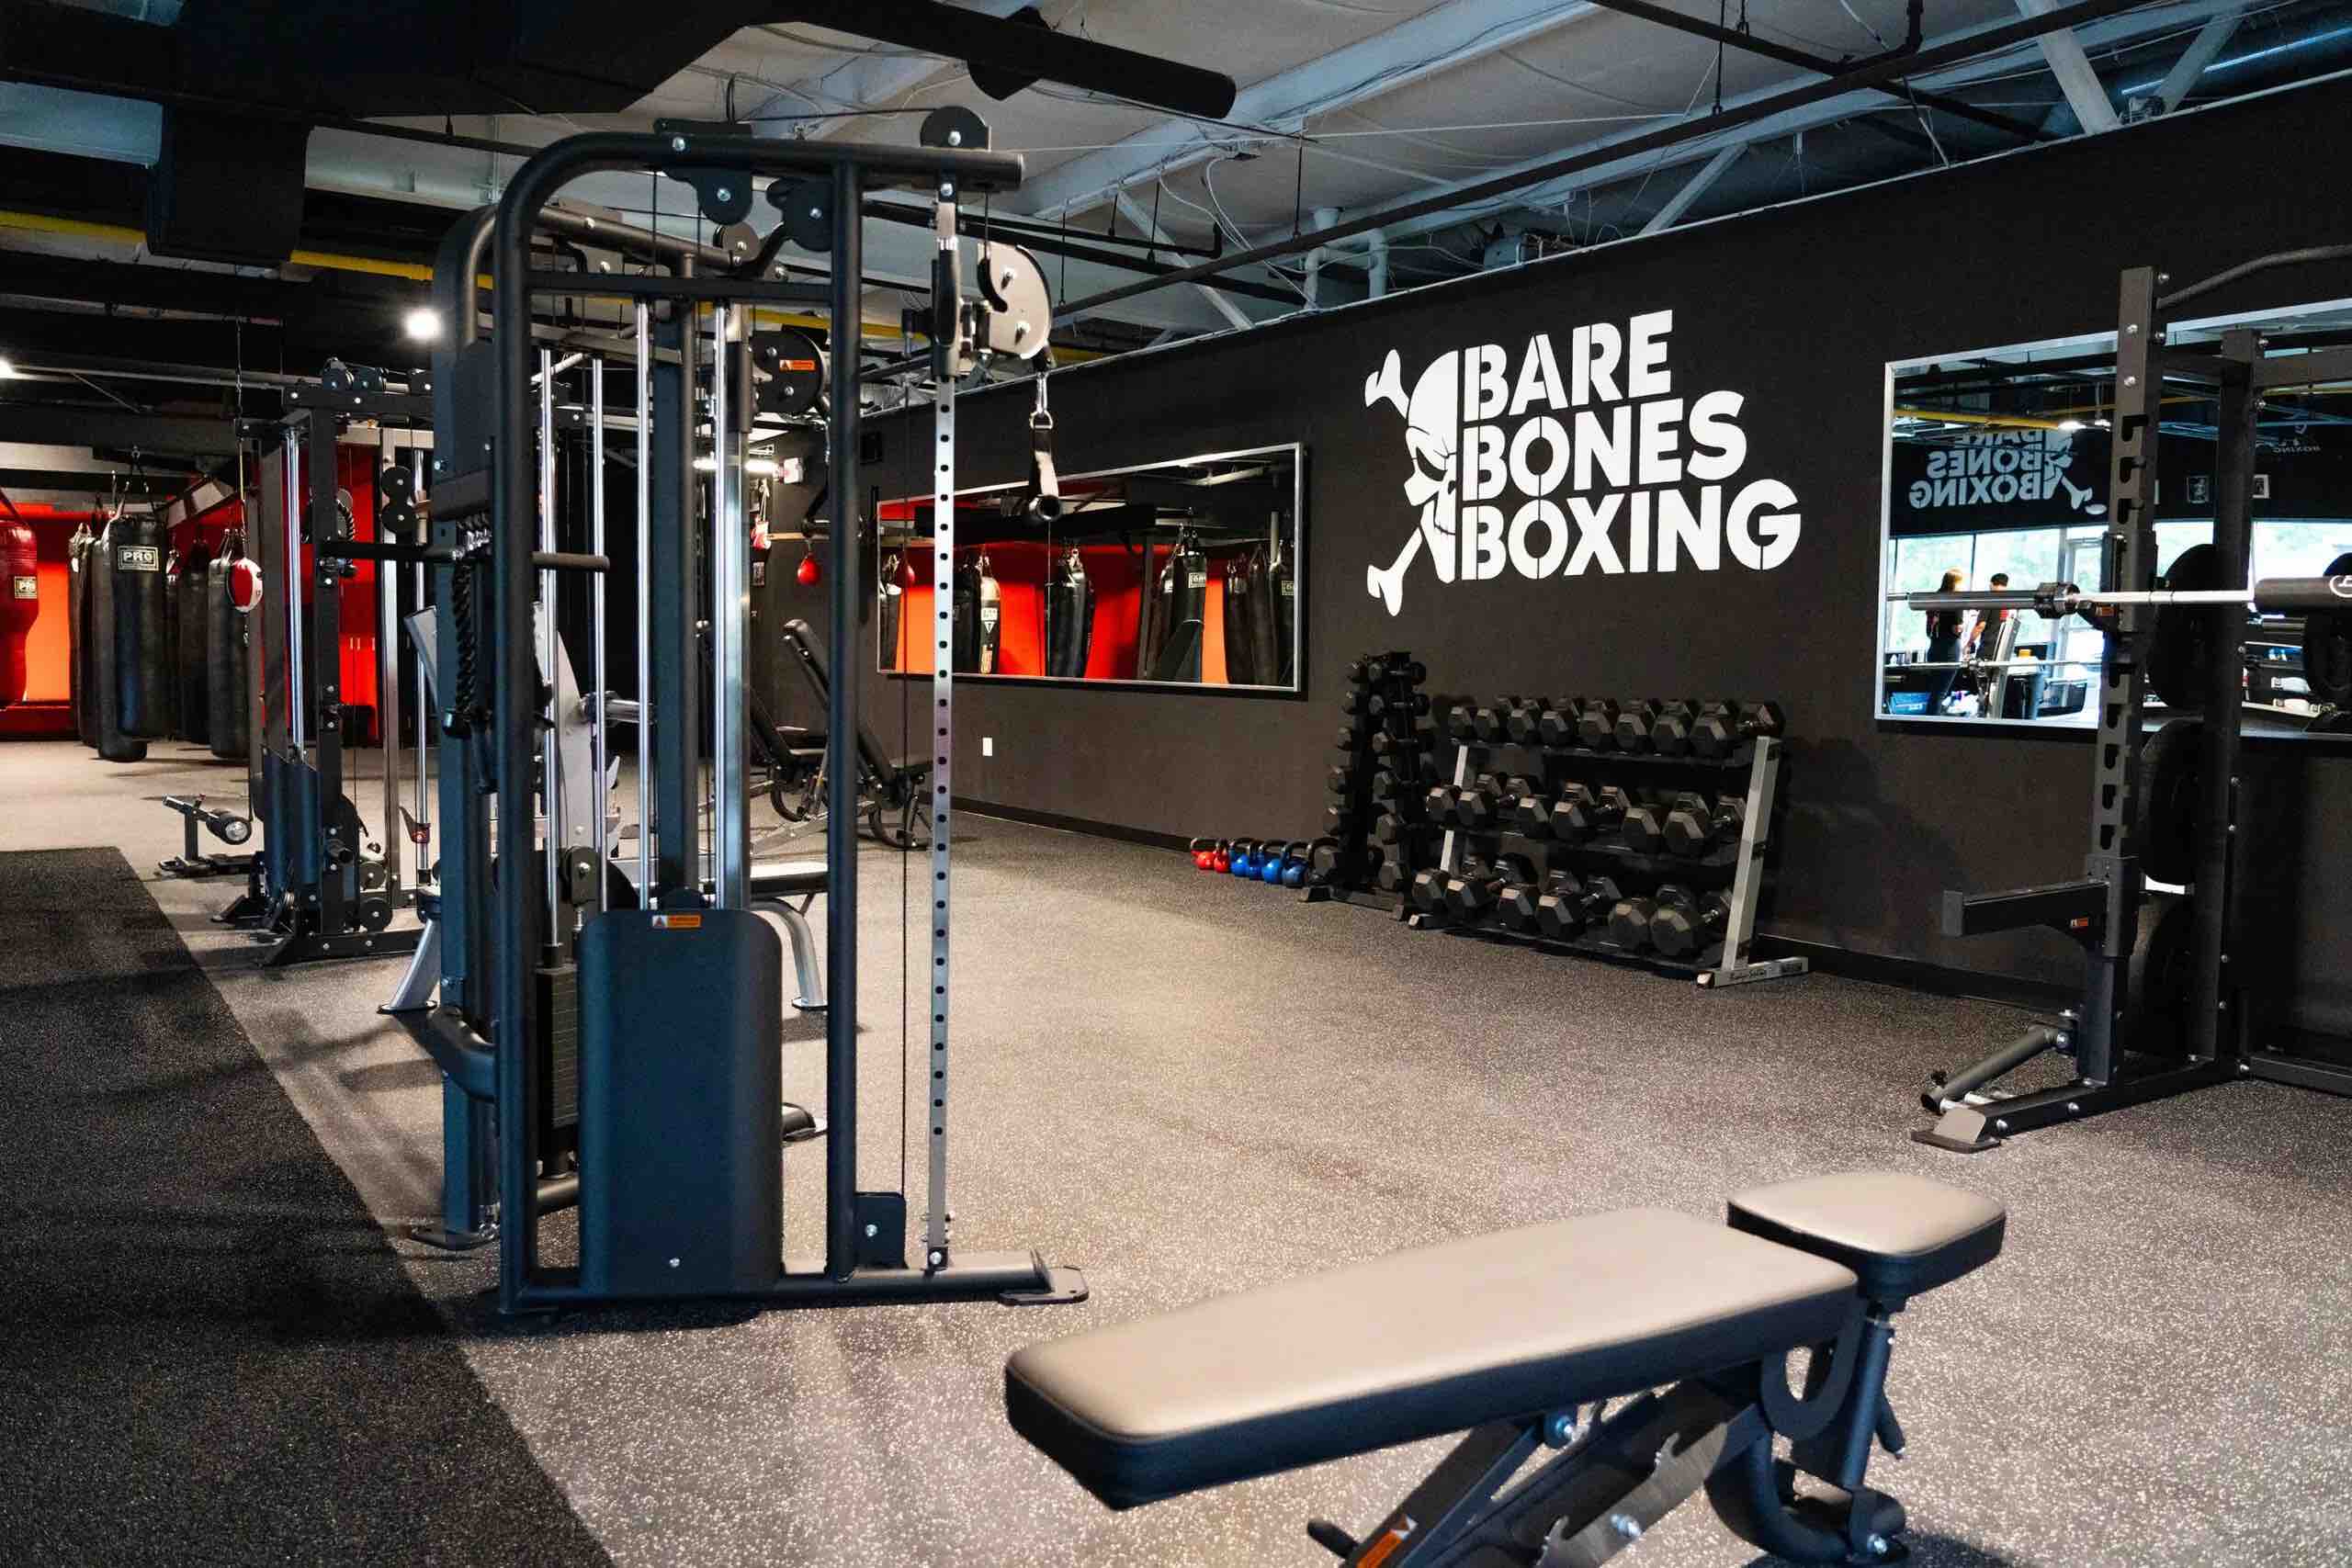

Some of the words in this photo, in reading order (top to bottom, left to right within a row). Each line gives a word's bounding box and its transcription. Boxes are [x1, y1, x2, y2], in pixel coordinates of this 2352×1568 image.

[1464, 310, 1673, 422] BARE
[1463, 389, 1747, 502] BONES
[123, 551, 153, 561] PRO
[1462, 479, 1801, 581] BOXING
